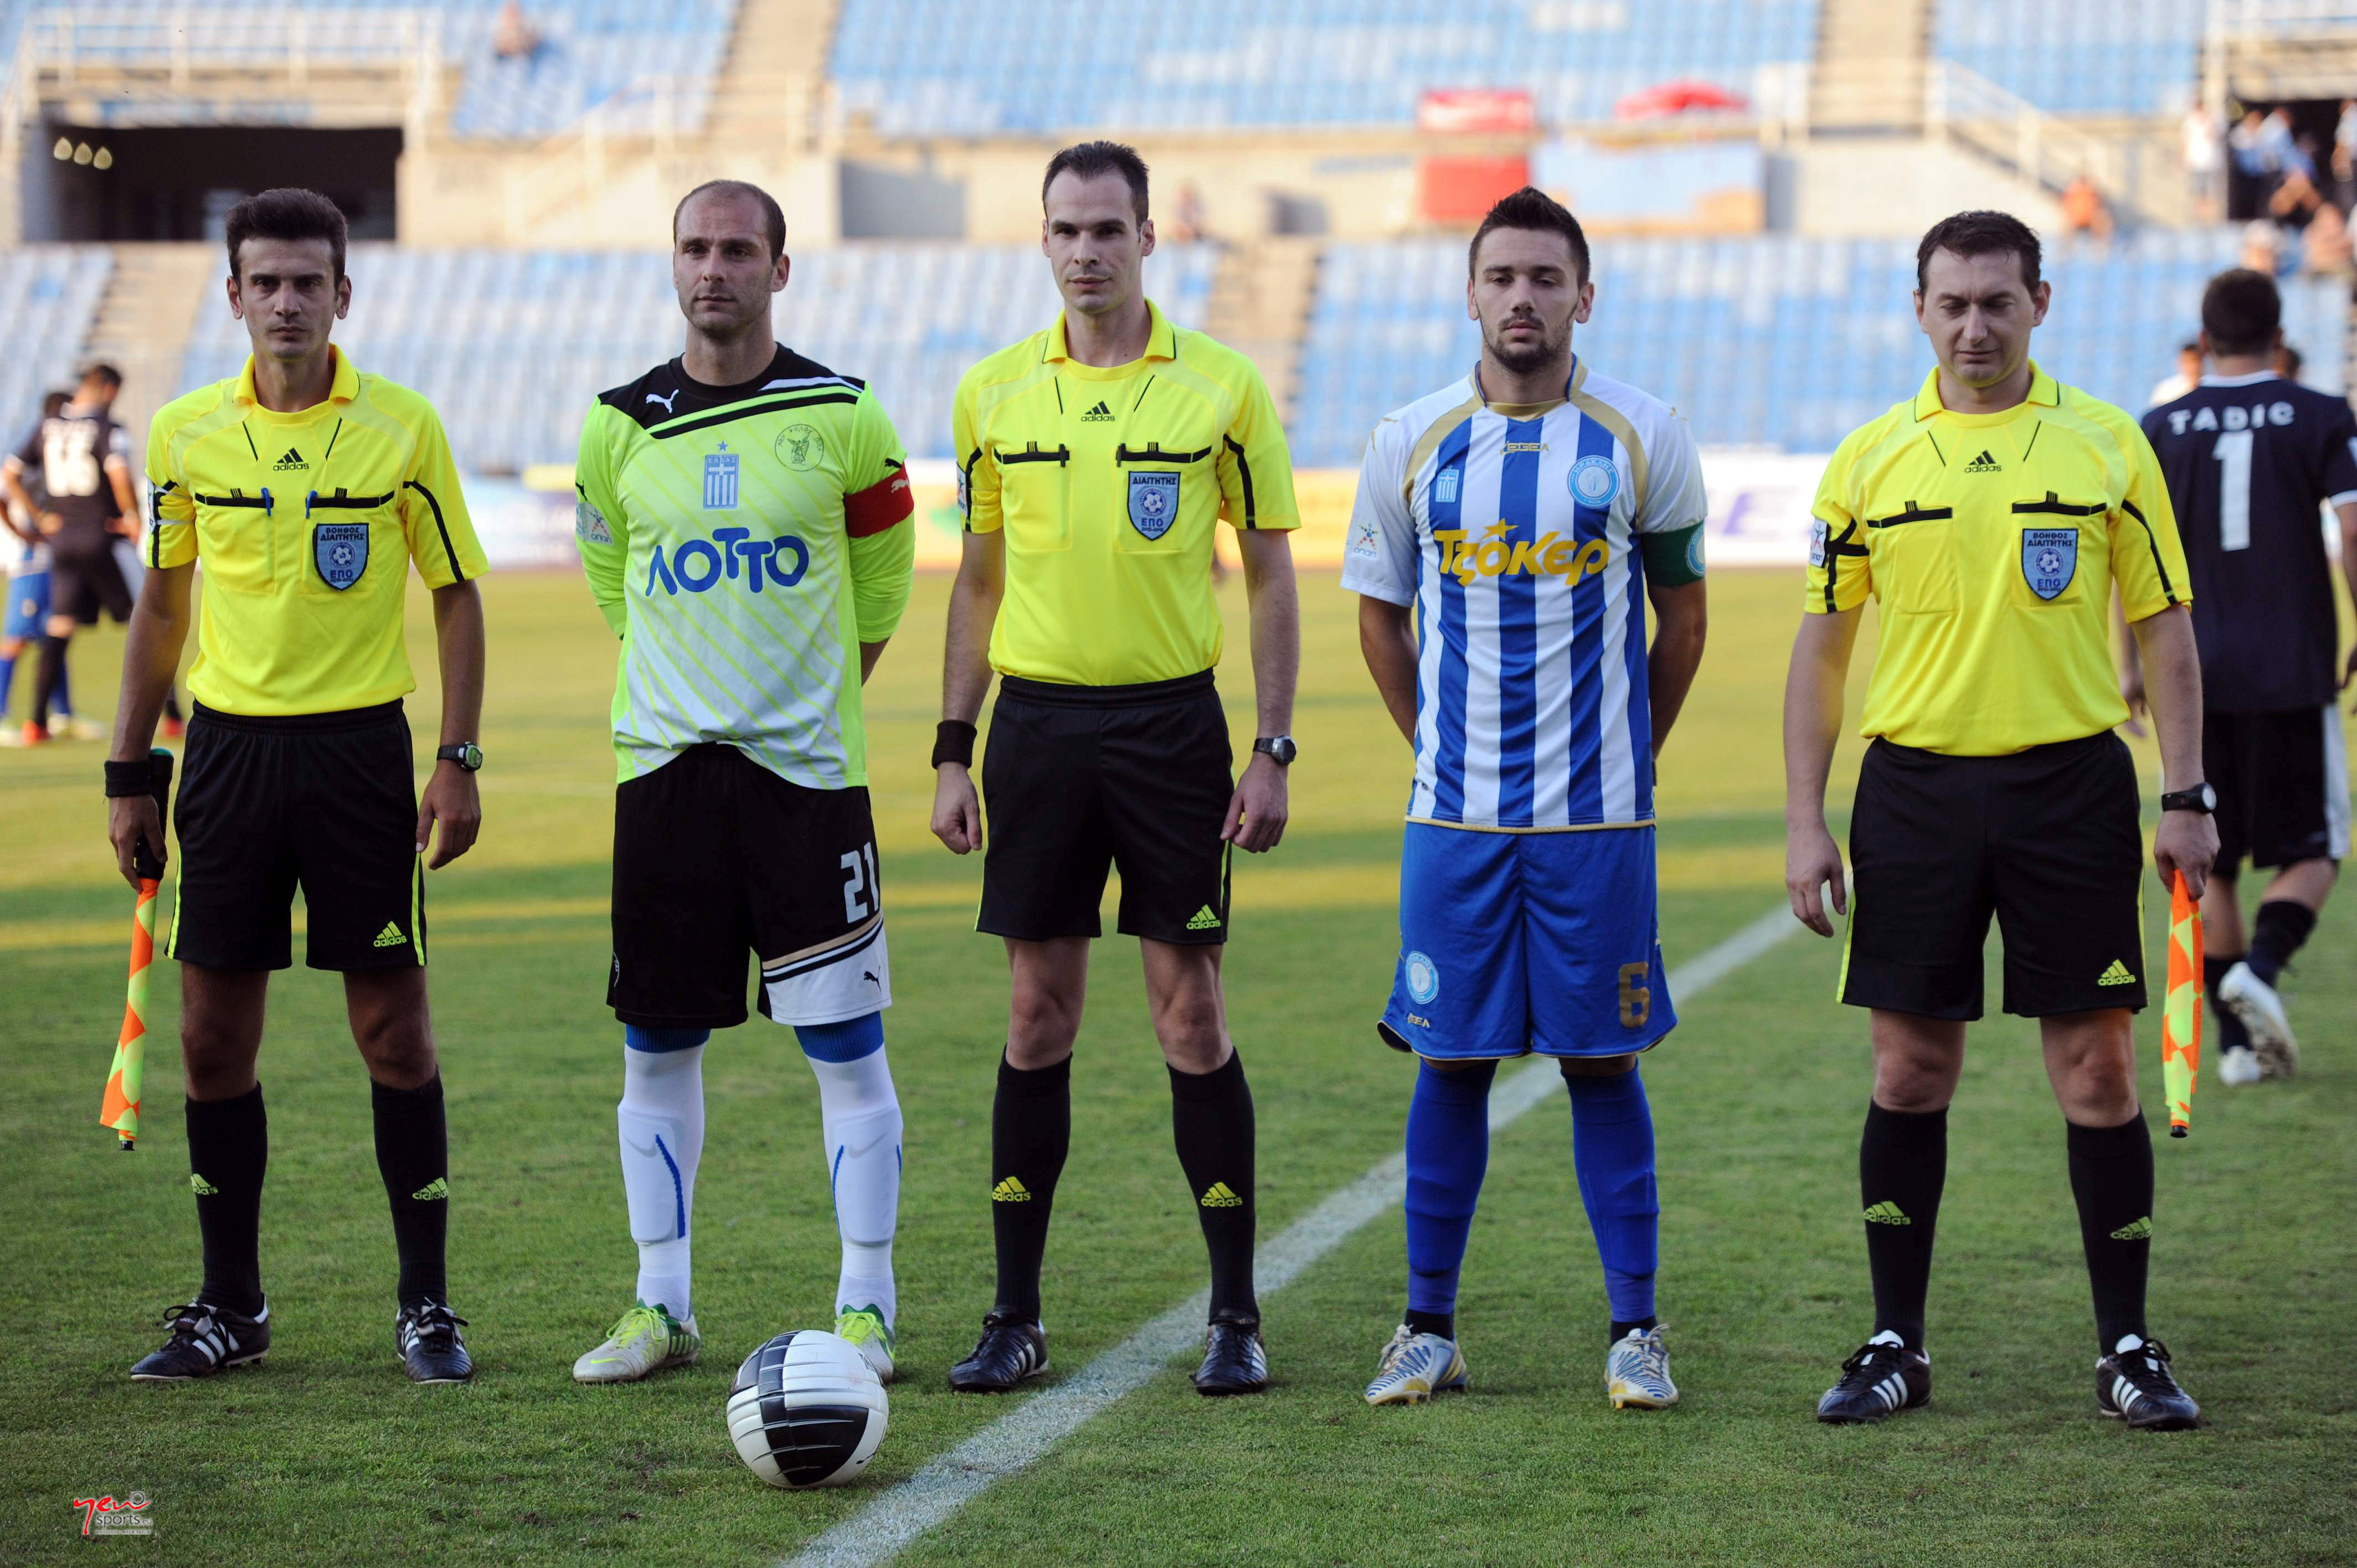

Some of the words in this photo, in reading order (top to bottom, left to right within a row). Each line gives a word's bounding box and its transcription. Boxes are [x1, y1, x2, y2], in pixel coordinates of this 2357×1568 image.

[273, 462, 309, 471] adidas
[1964, 463, 2002, 473] adidas
[2212, 429, 2254, 551] 1
[1141, 517, 1163, 527] ΕΠΟ
[330, 569, 353, 579] ΕΠΟ
[2037, 578, 2060, 587] ΕΠΟ
[841, 842, 879, 923] 21
[1186, 919, 1221, 930] adidas
[373, 935, 407, 947] adidas
[2097, 974, 2136, 986] adidas
[1618, 961, 1650, 1028] 6
[992, 1190, 1031, 1201] adidas
[1201, 1196, 1243, 1207] adidas
